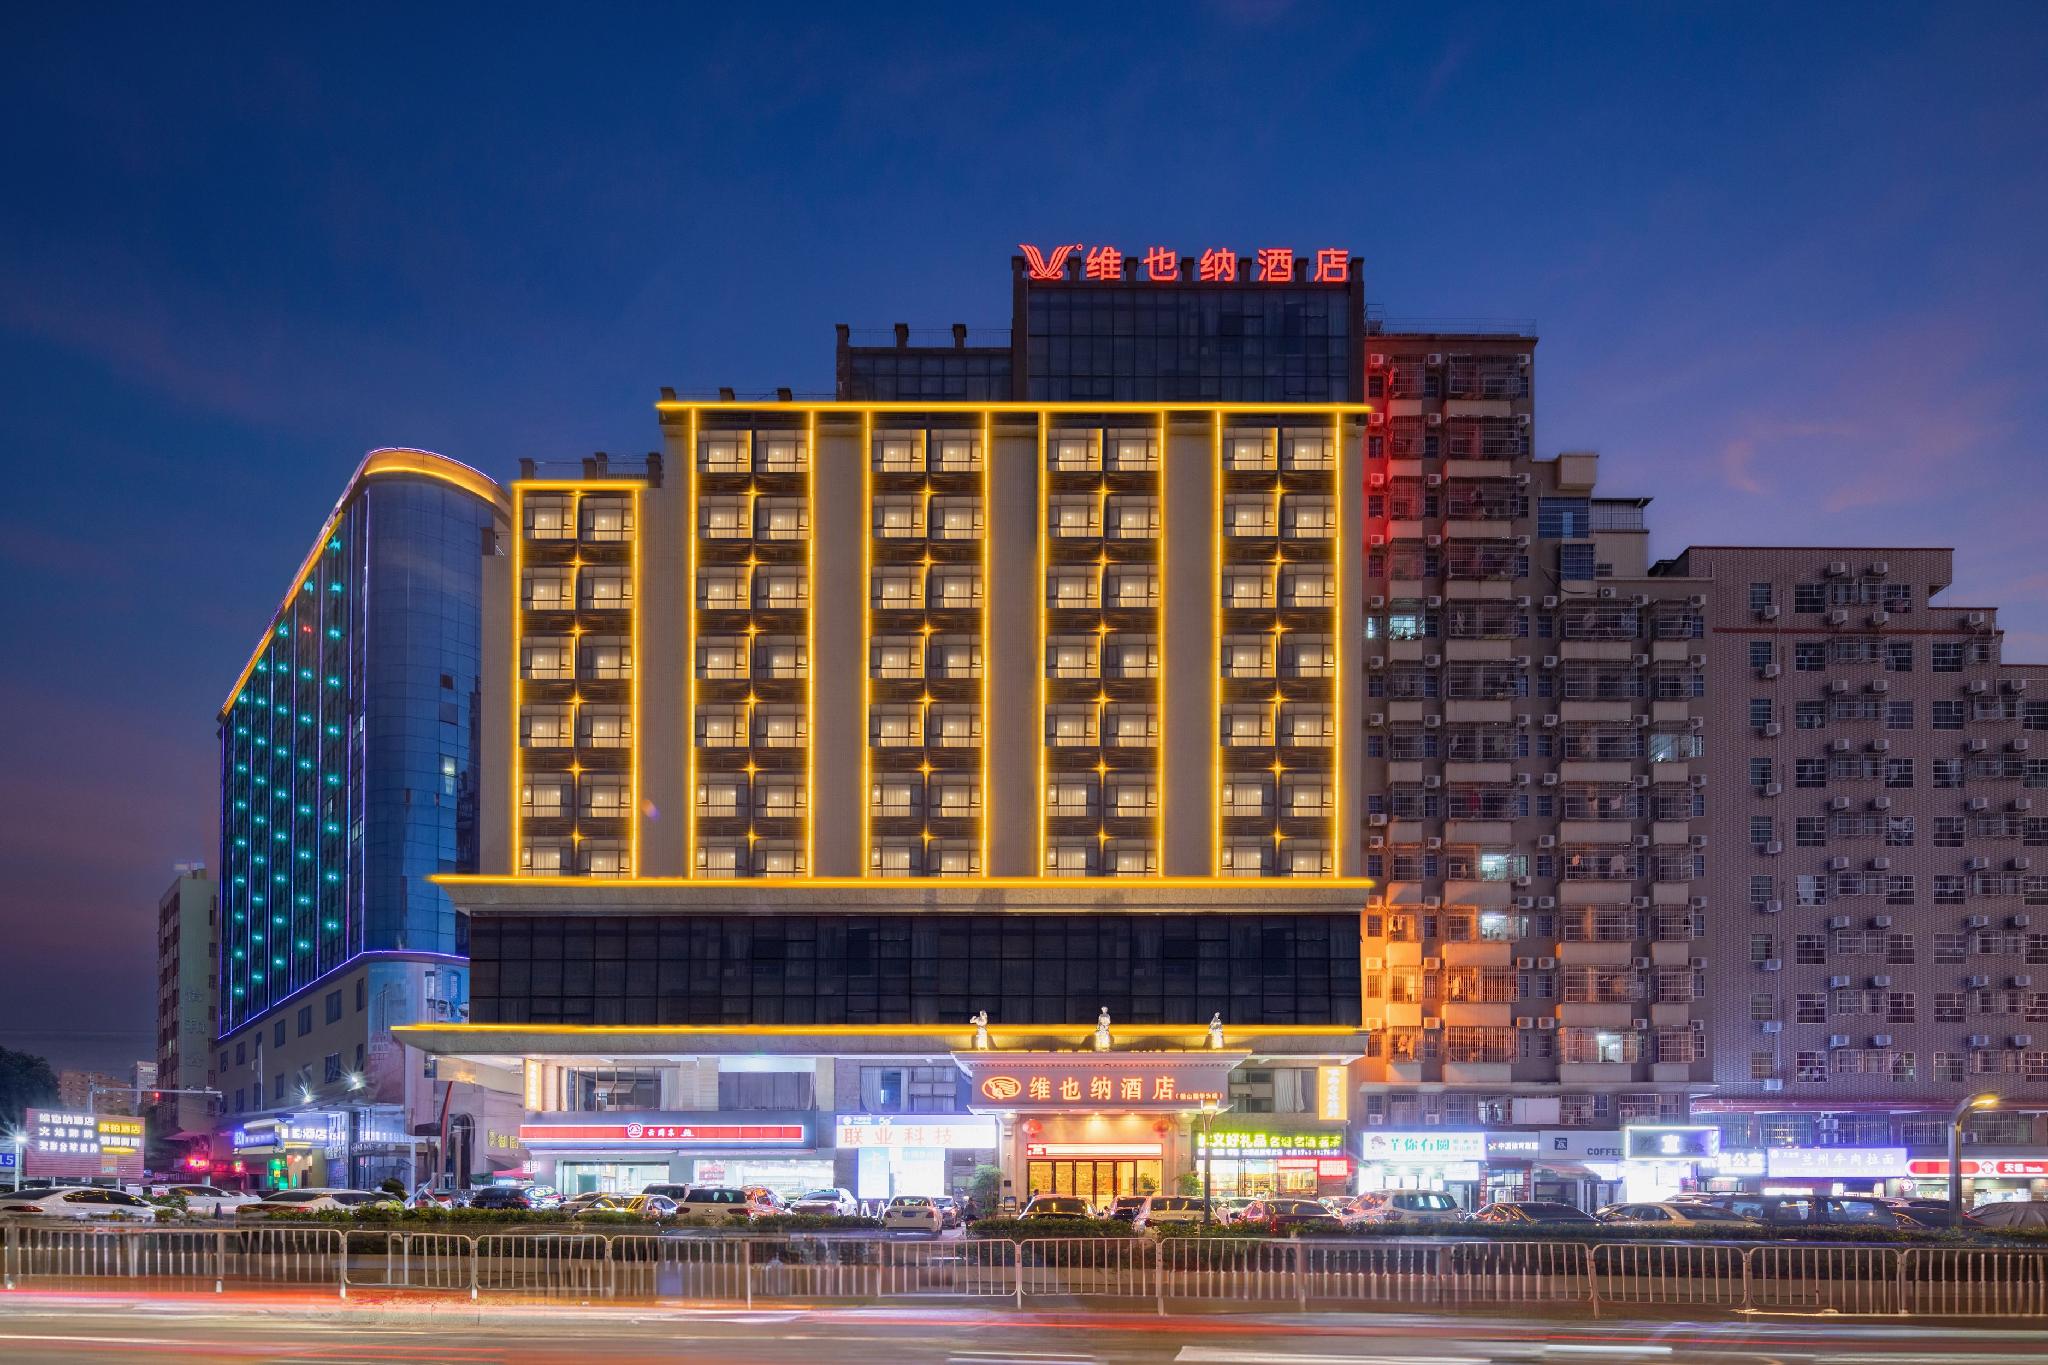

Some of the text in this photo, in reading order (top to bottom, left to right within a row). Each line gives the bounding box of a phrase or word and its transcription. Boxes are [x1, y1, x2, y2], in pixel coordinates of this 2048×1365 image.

[1086, 247, 1348, 282] 维也纳酒店
[1029, 1076, 1176, 1100] 维也纳酒店
[844, 1127, 952, 1145] 联业科技
[1587, 1148, 1624, 1156] COFFEE
[1801, 1152, 1894, 1167] 兰州牛肉拉面
